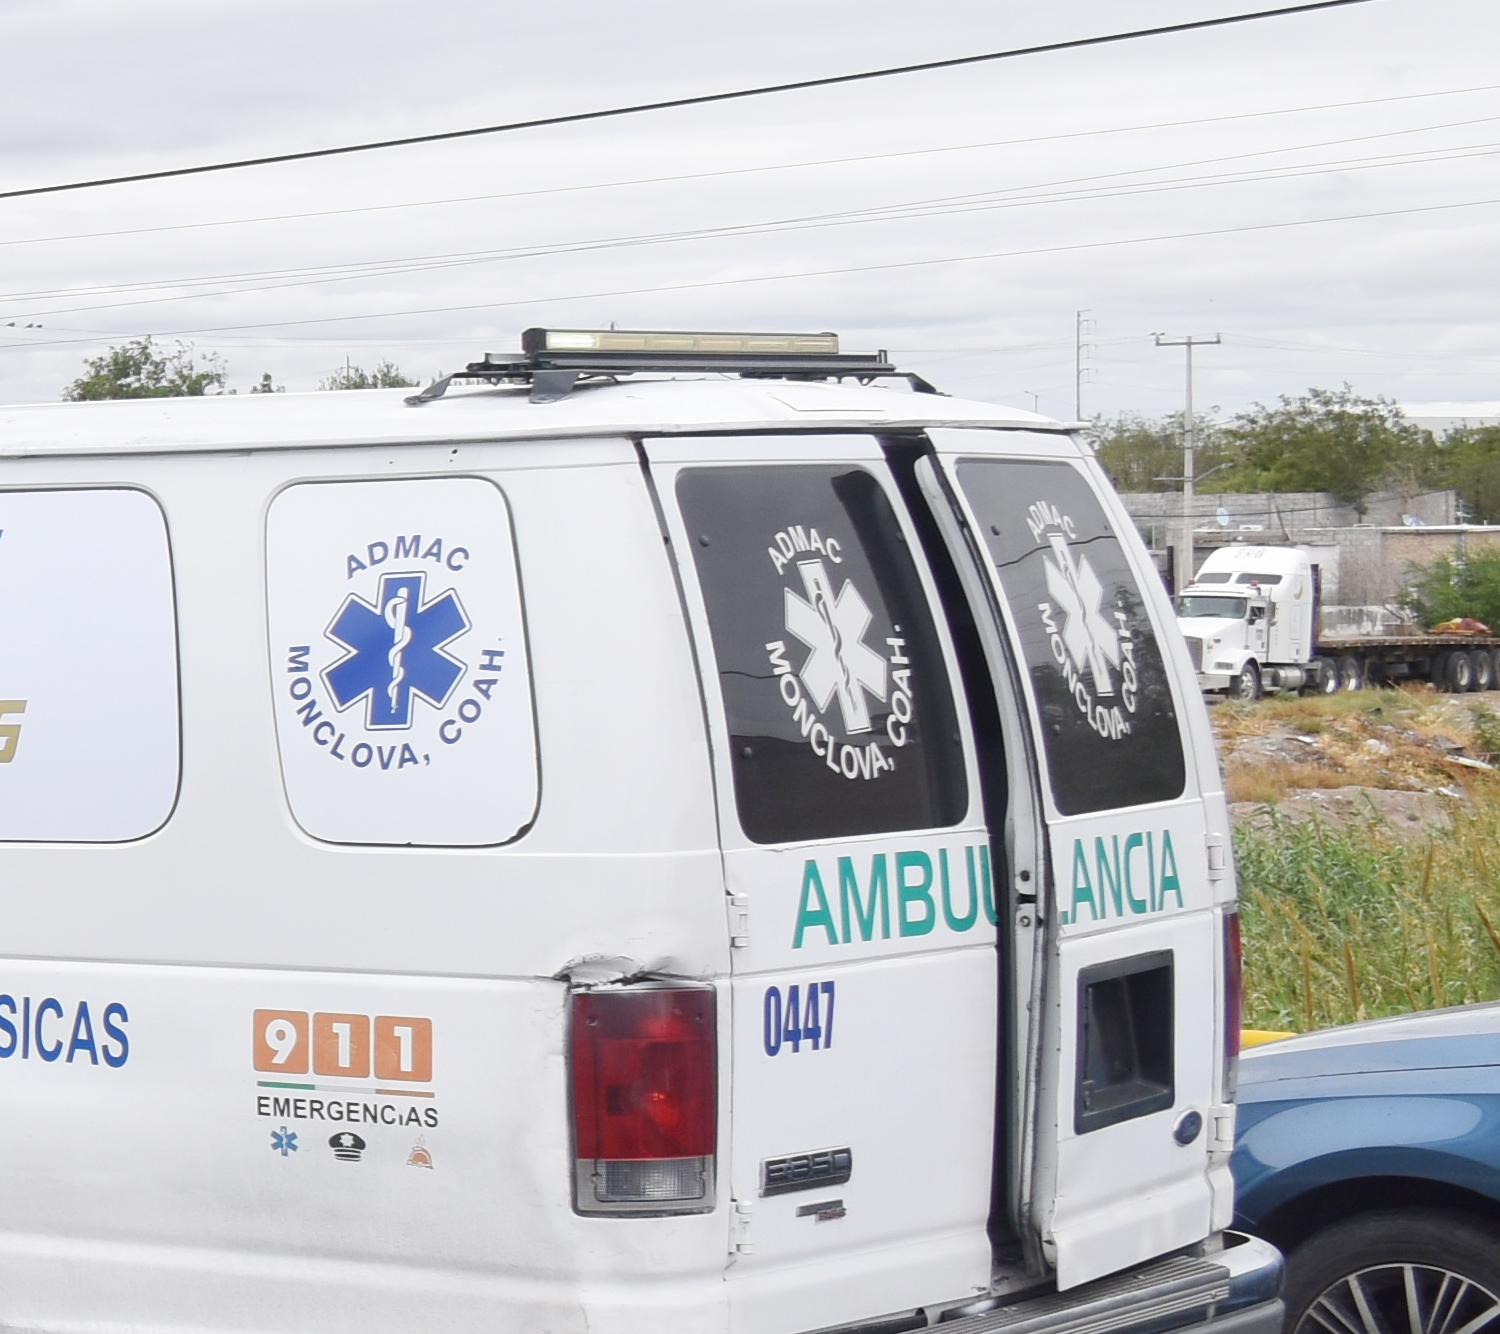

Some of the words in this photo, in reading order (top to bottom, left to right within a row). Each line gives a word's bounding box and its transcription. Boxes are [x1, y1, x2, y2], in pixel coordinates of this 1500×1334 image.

[768, 525, 843, 576] ADMAC
[1026, 500, 1077, 544] ADMAC
[346, 534, 471, 581] ADMAC
[764, 640, 896, 781] MONCLOVA,
[886, 624, 913, 748] COAH.
[1037, 601, 1132, 741] MONCLOVA,
[287, 645, 431, 771] MONCLOVA,
[264, 1018, 414, 1073] 911
[762, 980, 837, 1058] 0447
